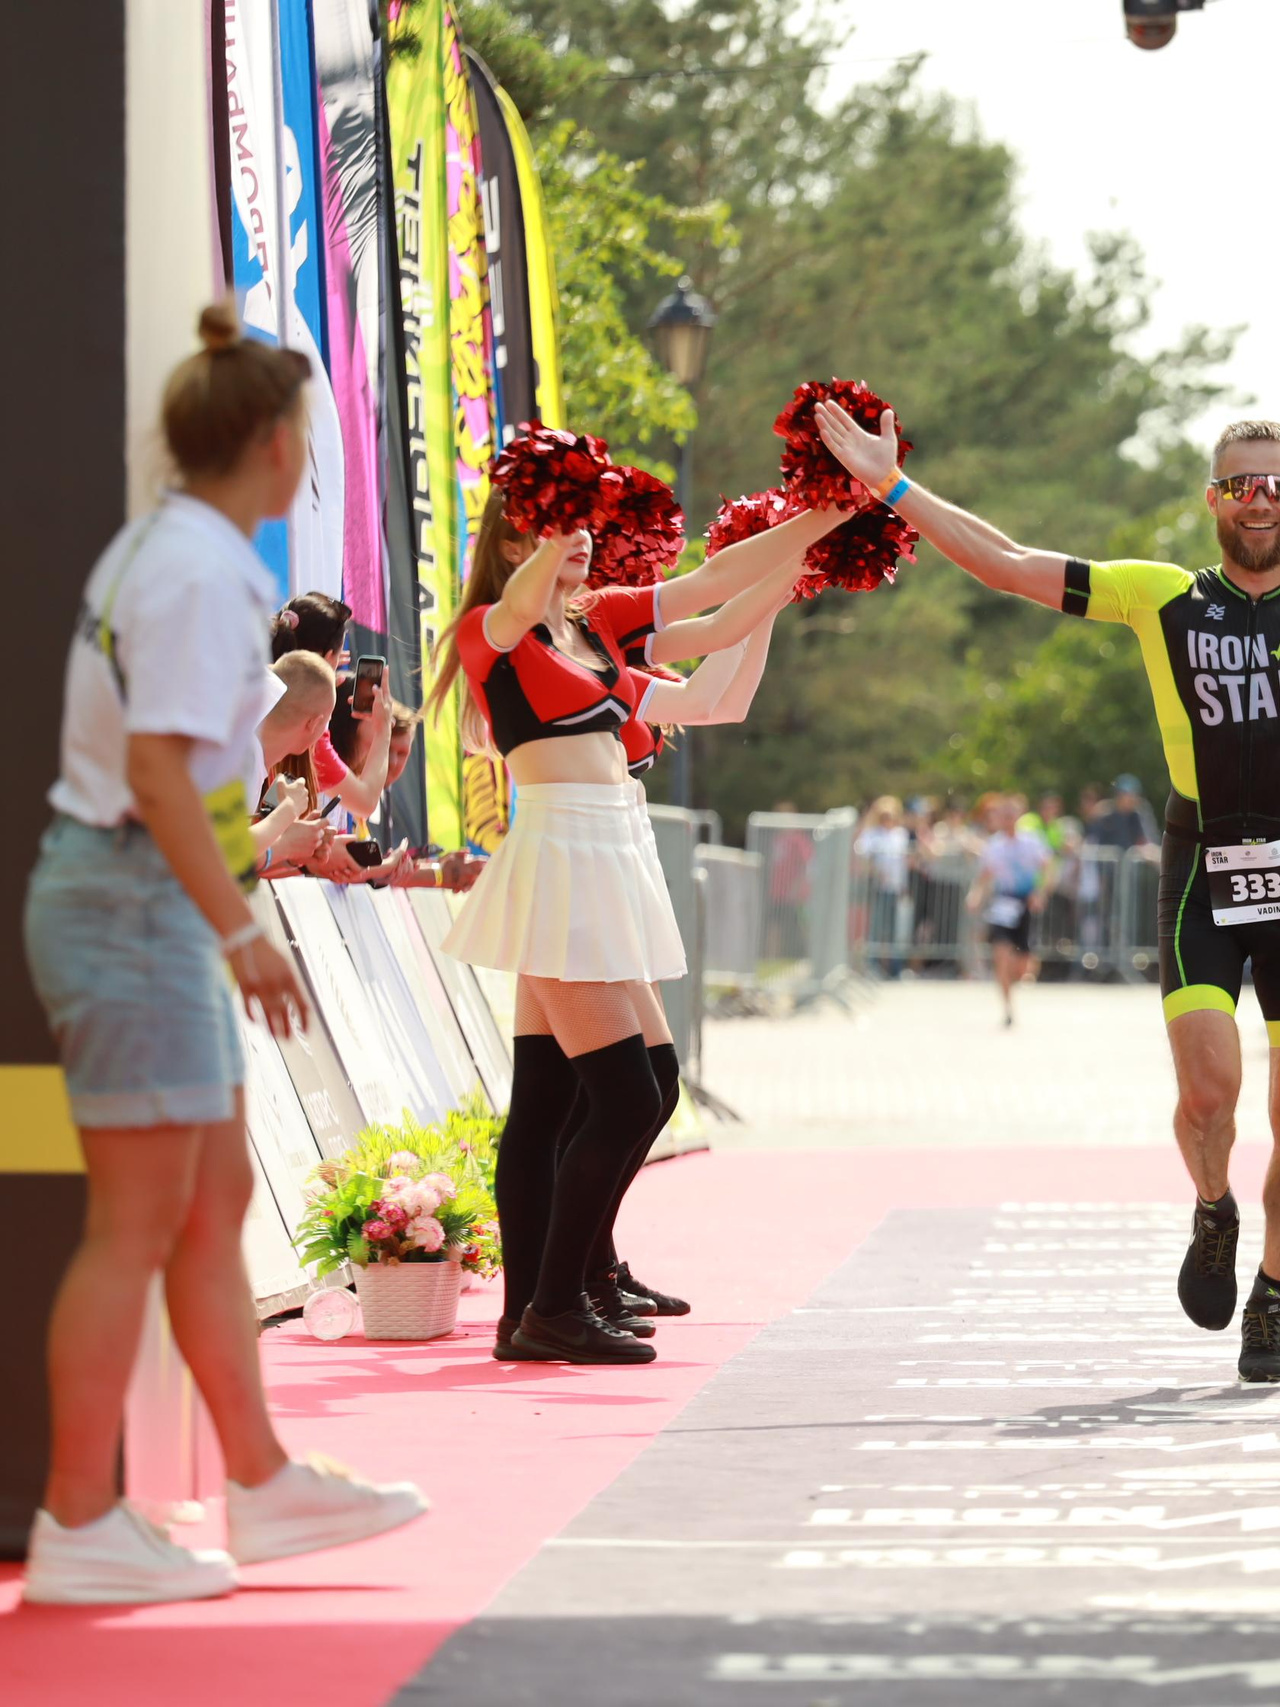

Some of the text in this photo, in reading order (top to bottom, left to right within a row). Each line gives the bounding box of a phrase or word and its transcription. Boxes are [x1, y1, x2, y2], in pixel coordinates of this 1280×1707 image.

[1187, 629, 1270, 671] IRON
[1212, 856, 1228, 864] STAR
[809, 1506, 1166, 1524] IRON
